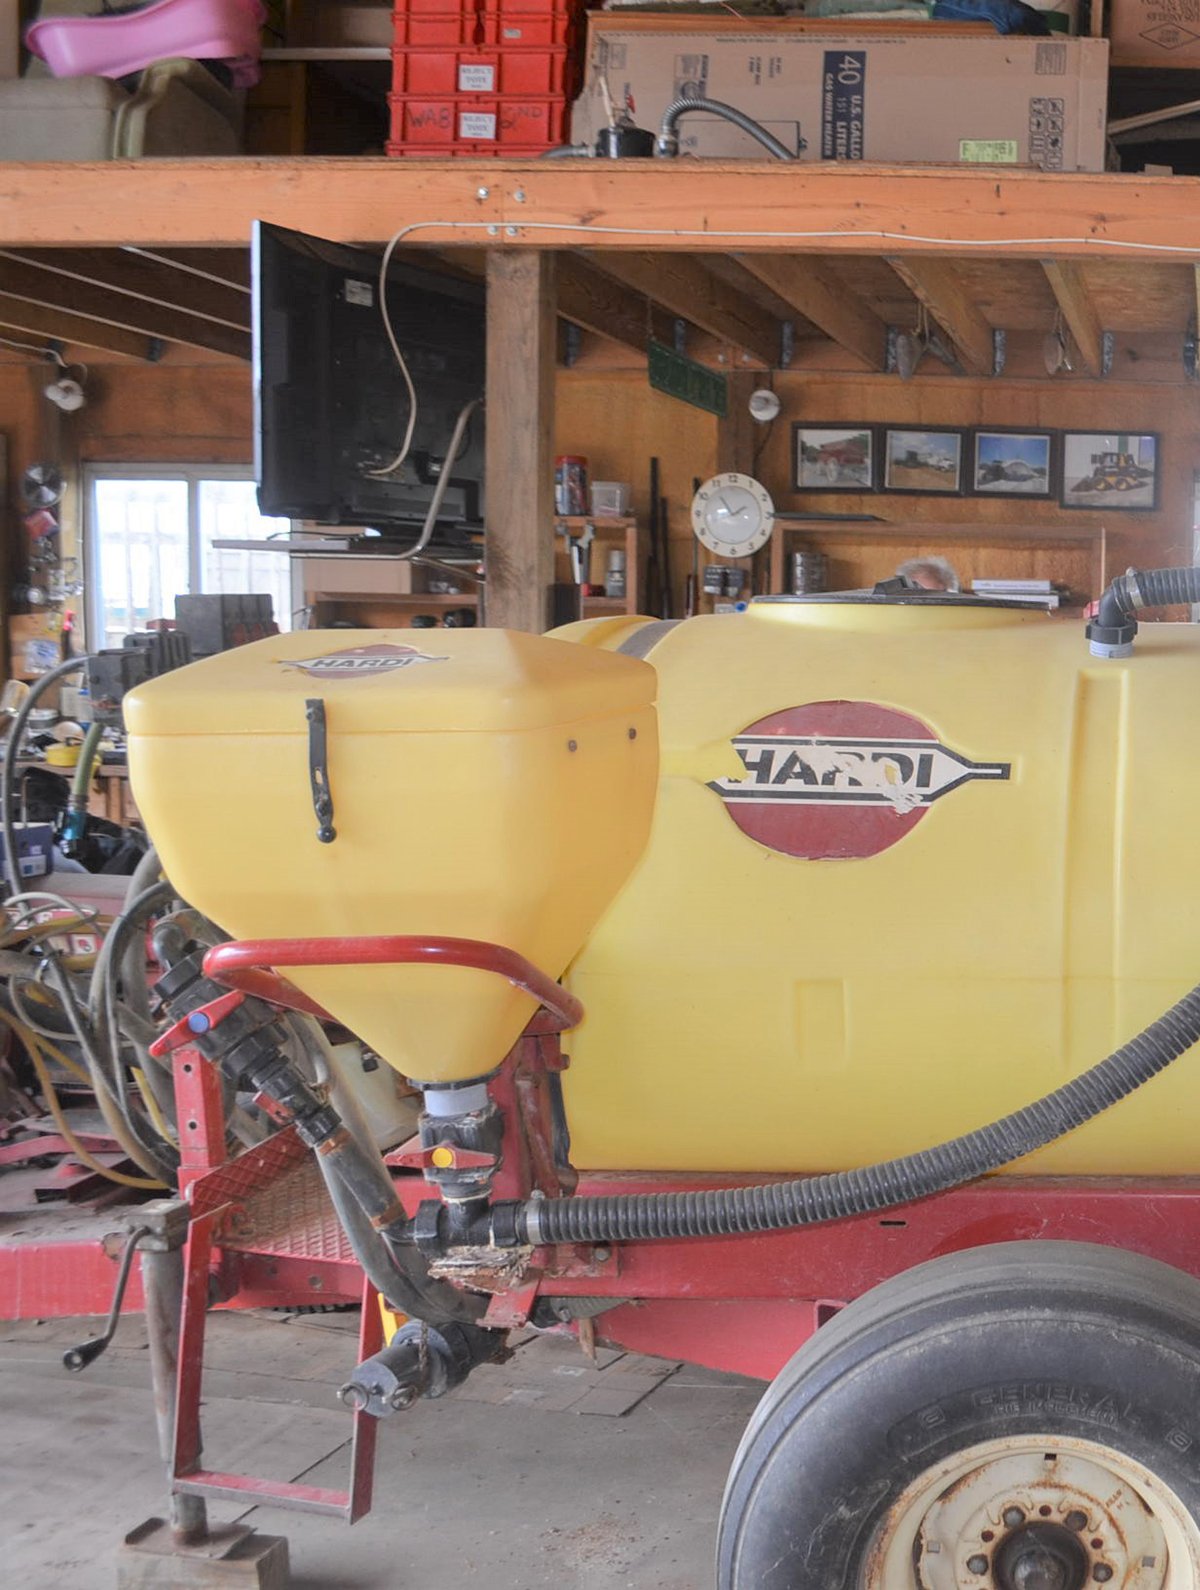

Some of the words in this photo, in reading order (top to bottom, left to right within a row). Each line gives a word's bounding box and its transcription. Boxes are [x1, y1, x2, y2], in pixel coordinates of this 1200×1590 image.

[825, 72, 834, 90] GAS
[838, 55, 862, 85] 40
[850, 95, 862, 117] U.S.
[824, 92, 833, 121] WATER
[823, 123, 833, 156] HEATER
[712, 479, 721, 487] 11
[728, 474, 738, 483] 12
[312, 657, 415, 668] HARDI
